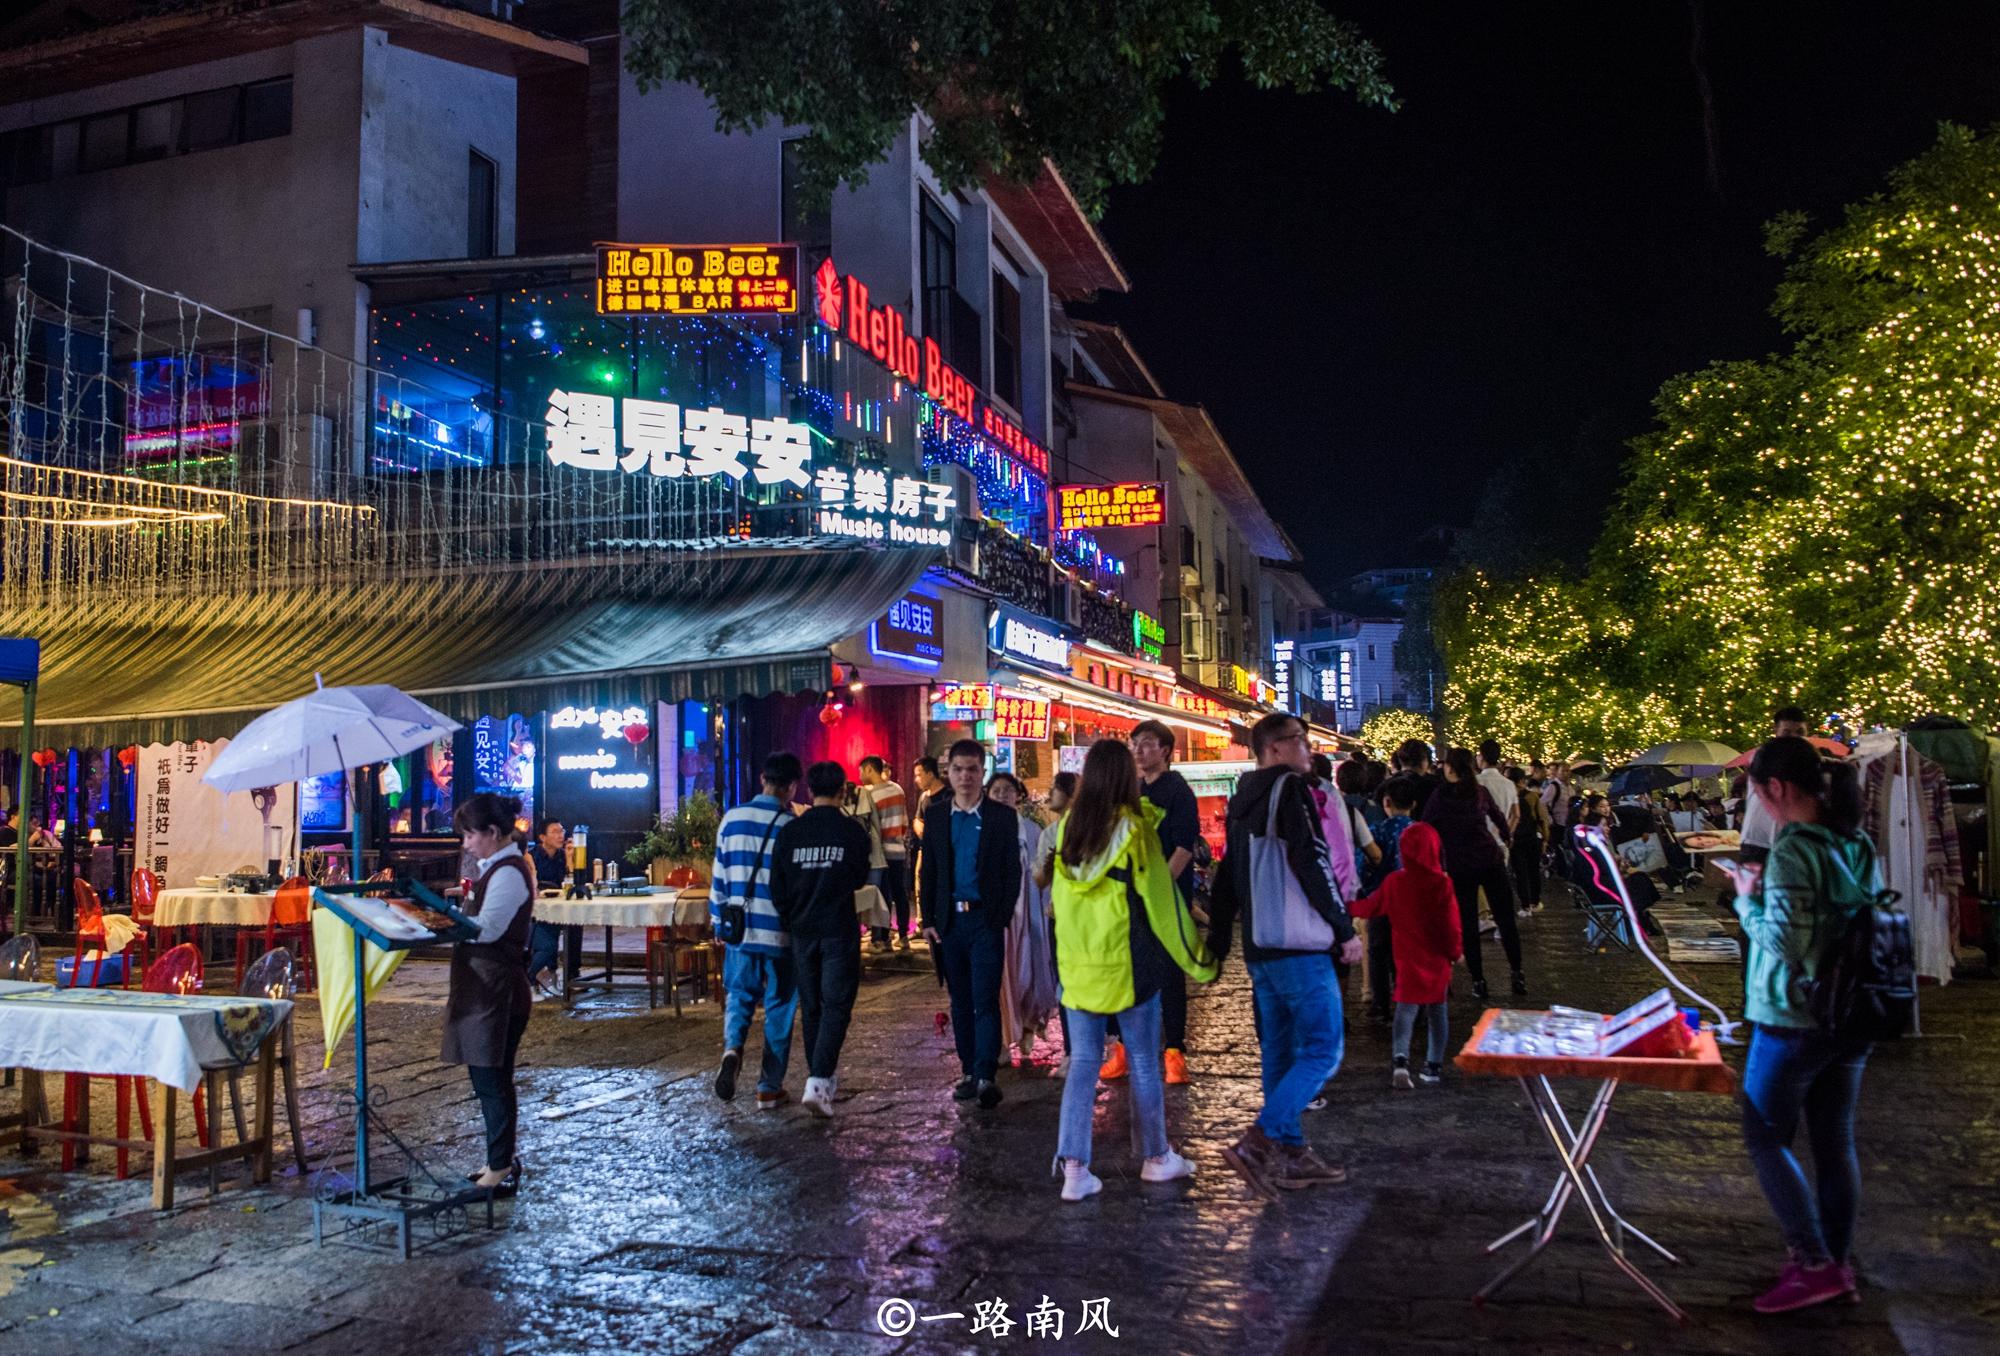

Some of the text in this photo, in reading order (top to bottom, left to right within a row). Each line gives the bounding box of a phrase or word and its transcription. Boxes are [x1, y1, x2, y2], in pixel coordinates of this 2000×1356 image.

[607, 250, 780, 277] Hello Beer
[606, 278, 734, 294] 进口啤酒体验馆
[692, 295, 733, 309] BAR
[847, 274, 920, 384] Hello
[925, 335, 976, 426] Beer
[544, 388, 812, 489] 遇見安安
[814, 465, 957, 522] 音樂房子
[1062, 487, 1156, 507] Hello Beer
[820, 511, 951, 546] Music house
[996, 698, 1046, 719] 特价机票
[996, 717, 1046, 737] 景点门票
[590, 771, 649, 789] house
